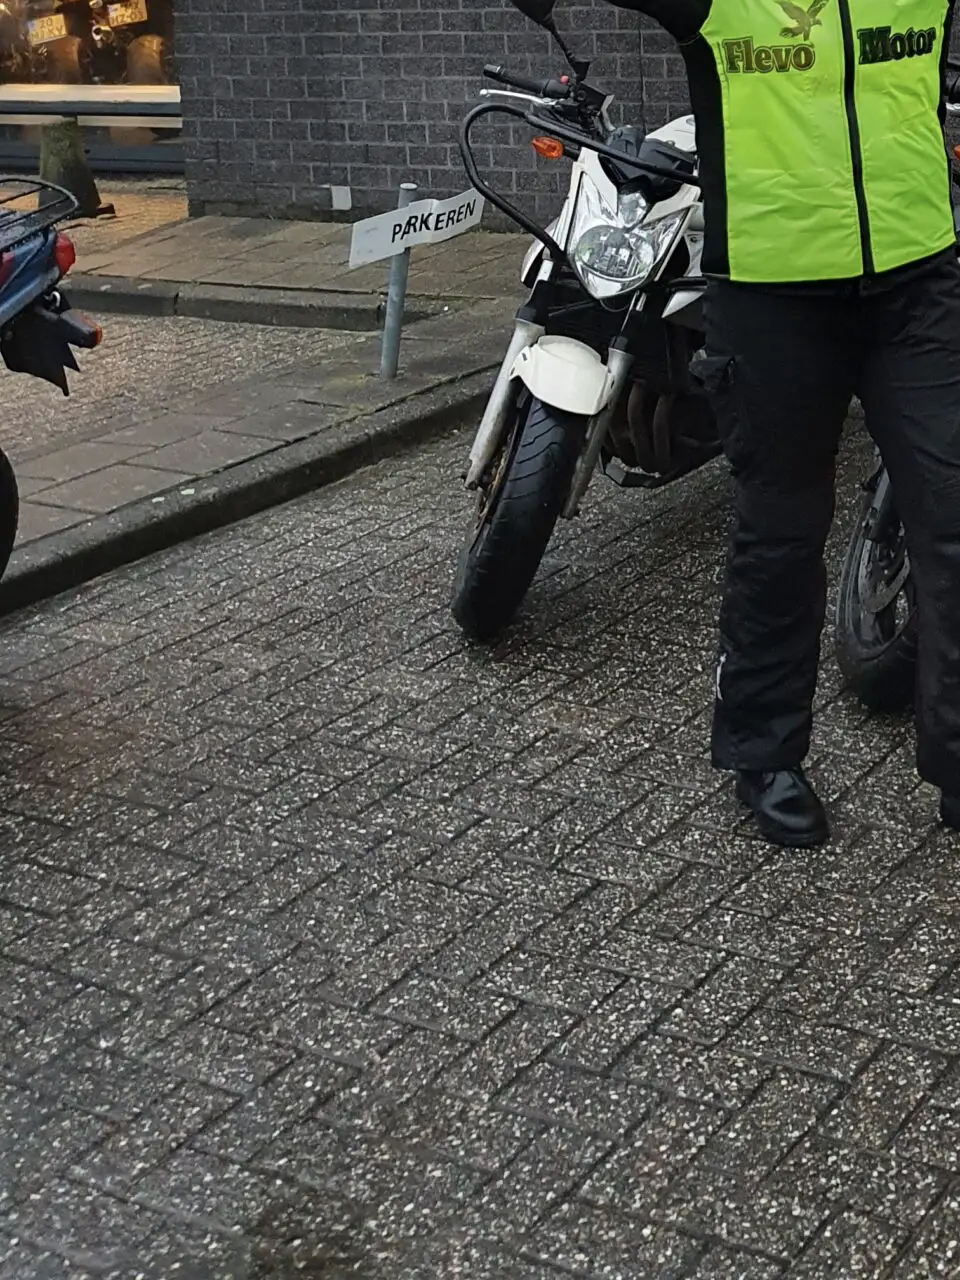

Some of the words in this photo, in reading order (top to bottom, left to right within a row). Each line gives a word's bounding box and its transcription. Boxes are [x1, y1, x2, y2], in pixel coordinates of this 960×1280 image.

[722, 35, 816, 74] Flevo
[857, 25, 937, 65] Motor
[391, 199, 477, 244] PARKEREN
